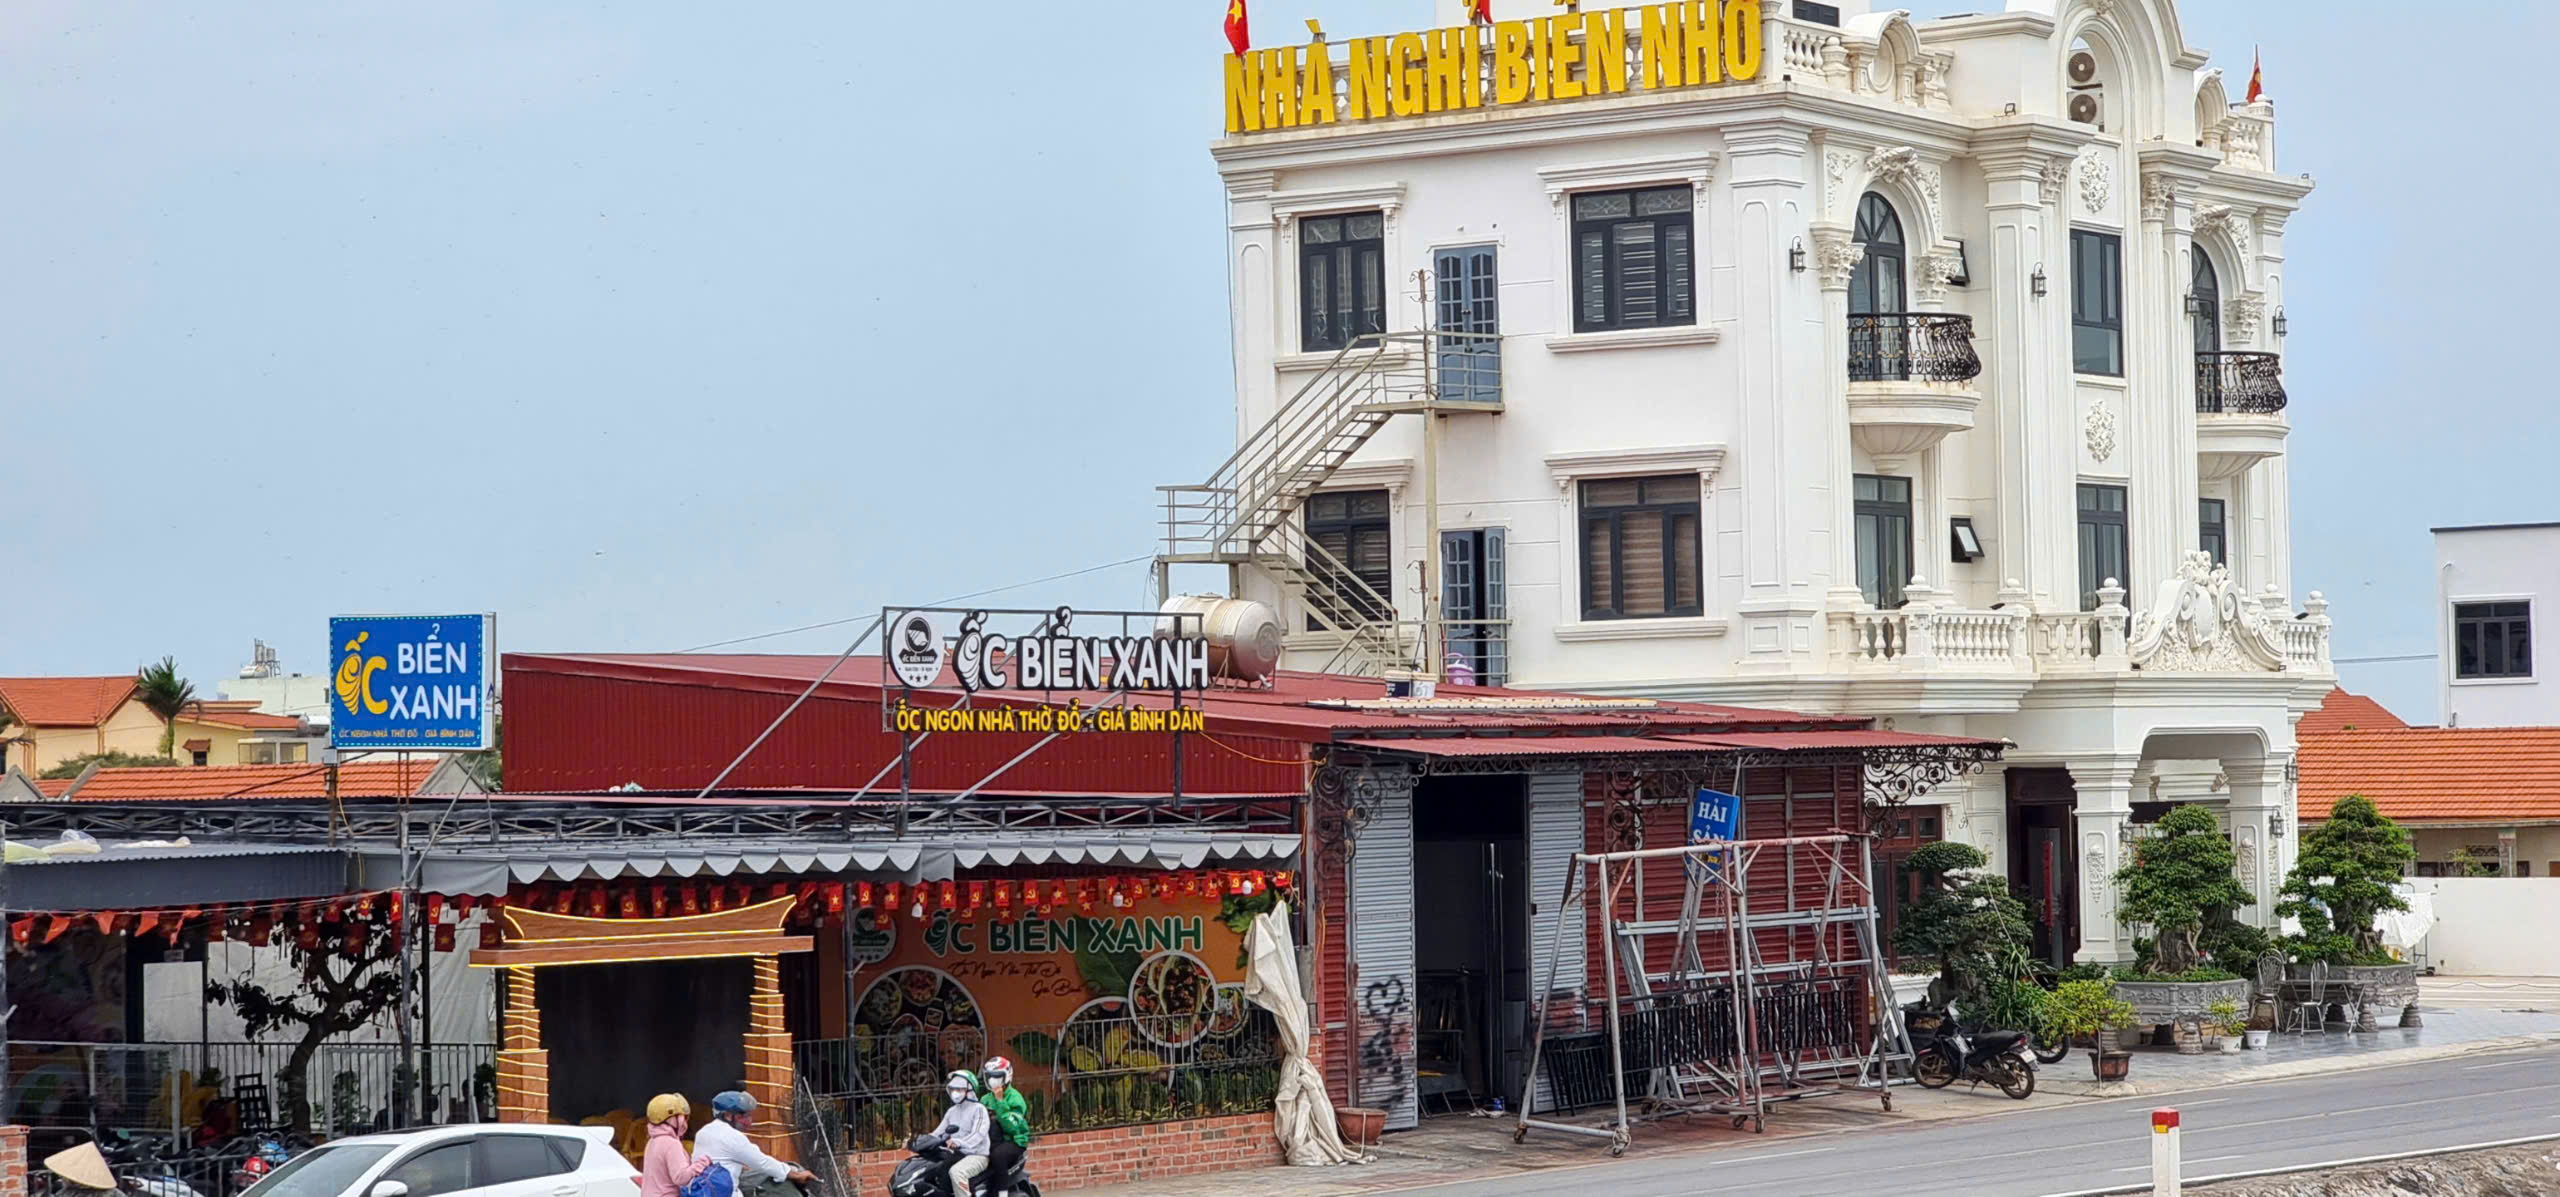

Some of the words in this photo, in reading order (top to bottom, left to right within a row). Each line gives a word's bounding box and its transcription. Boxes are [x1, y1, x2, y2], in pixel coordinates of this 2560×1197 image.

[1224, 19, 1336, 133] NHÀ
[1349, 0, 1481, 120] NGHỈ
[956, 609, 1007, 692] ỐC
[1019, 606, 1100, 688] BIỂN
[1110, 636, 1208, 689] XANH
[335, 631, 389, 715] ỐC
[397, 622, 467, 675] BIỂN
[389, 684, 477, 720] XANH
[897, 699, 920, 731] ỐC
[925, 709, 974, 732] NGON
[978, 704, 1014, 732] NHÀ
[1019, 704, 1053, 732] THỜ
[1098, 704, 1126, 732] GIÁ
[1130, 704, 1166, 731] BÌNH
[1168, 704, 1205, 731] DÂN
[1698, 798, 1727, 823] HẢI
[1089, 916, 1203, 953] XANH
